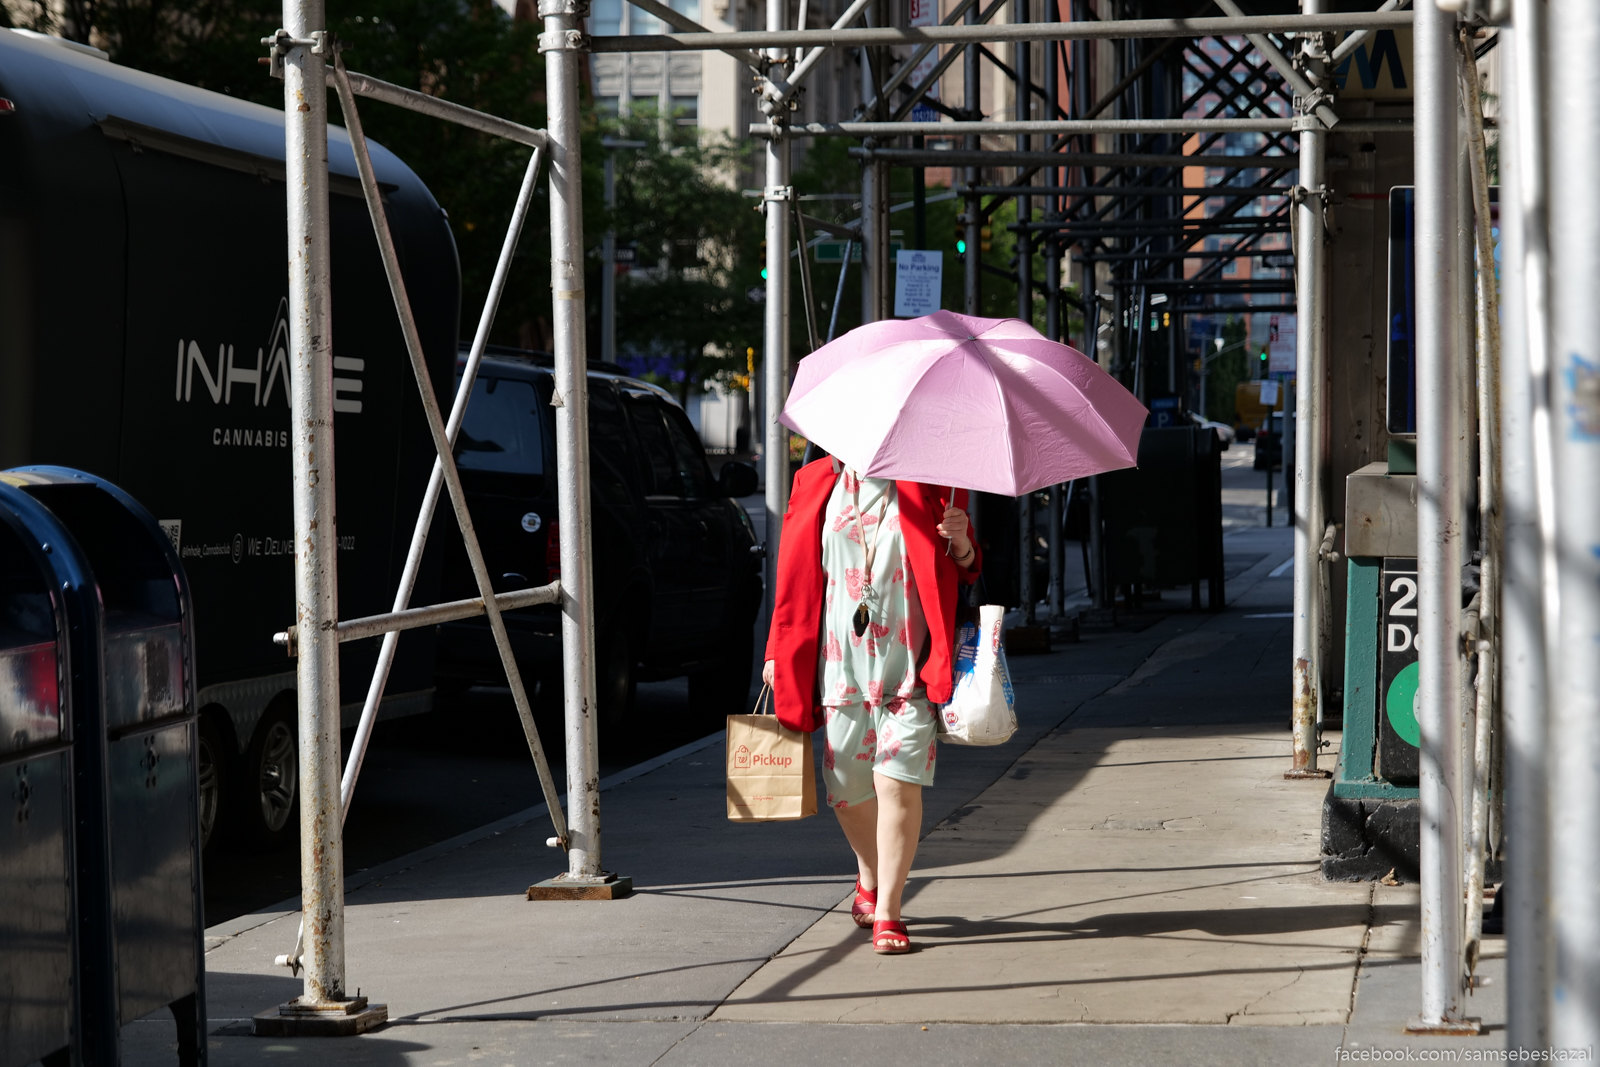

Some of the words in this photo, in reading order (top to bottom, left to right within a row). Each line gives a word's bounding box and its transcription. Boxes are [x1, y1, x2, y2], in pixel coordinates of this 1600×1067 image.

[899, 263, 909, 271] No
[911, 263, 940, 273] Parking
[176, 338, 365, 414] INHAE
[213, 428, 288, 447] CANNABIS
[264, 536, 296, 556] DELIVE
[1389, 577, 1418, 616] 2
[753, 753, 793, 768] Pickup
